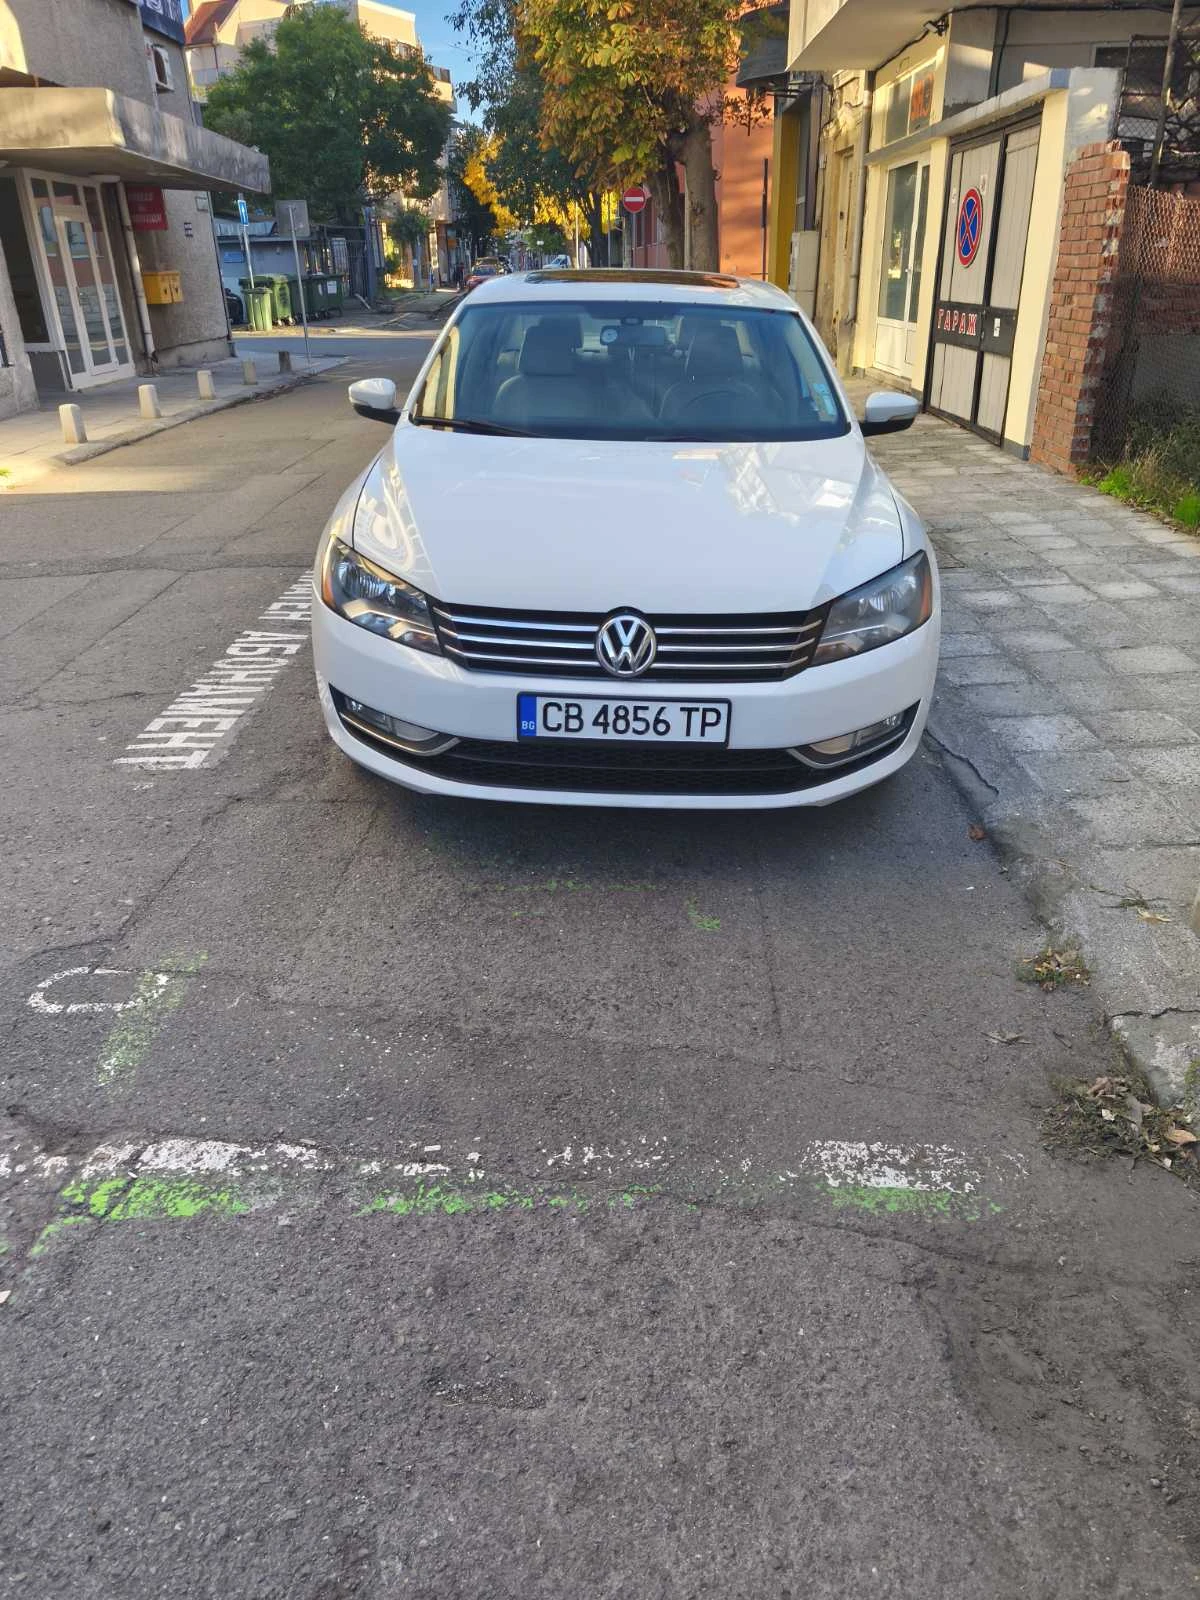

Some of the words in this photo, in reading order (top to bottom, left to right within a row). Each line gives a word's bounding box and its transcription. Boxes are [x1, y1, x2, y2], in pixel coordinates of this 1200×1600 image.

[937, 308, 978, 336] ГАРАЖ
[599, 617, 654, 675] VW
[113, 630, 308, 769] АБОНАМЕНТ
[521, 720, 535, 730] BG
[542, 701, 584, 733] CB
[592, 703, 671, 737] 4856
[679, 706, 722, 738] TP
